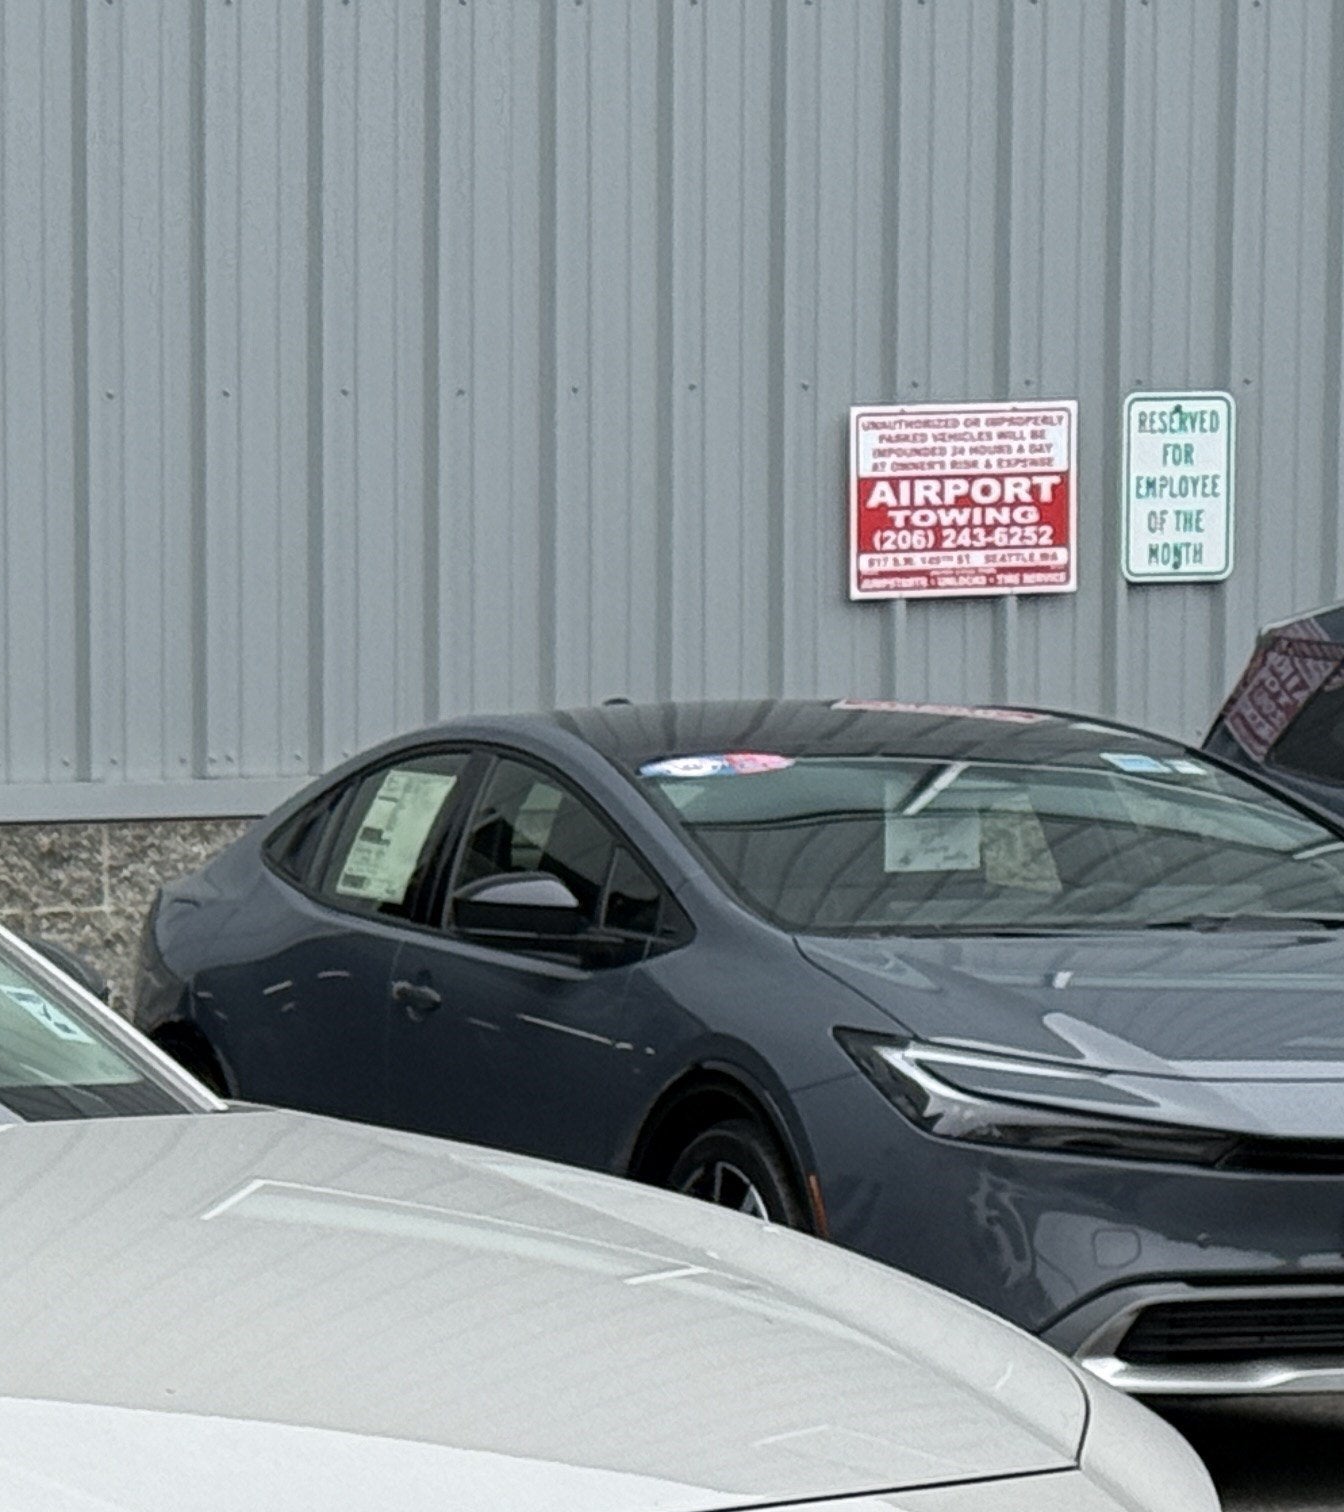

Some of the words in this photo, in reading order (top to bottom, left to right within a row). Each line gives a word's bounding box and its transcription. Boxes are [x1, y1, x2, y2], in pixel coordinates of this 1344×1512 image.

[1138, 409, 1221, 435] RESERVED
[1162, 443, 1195, 466] FOR
[865, 475, 1062, 508] AIRPORT
[1135, 474, 1221, 499] EMPLOYEE
[888, 505, 1041, 527] TOWING
[1147, 509, 1169, 534] OF
[1174, 508, 1205, 533] THE
[873, 527, 935, 552] (206)
[942, 525, 1054, 548] 243-6252
[1148, 541, 1204, 566] MONTH
